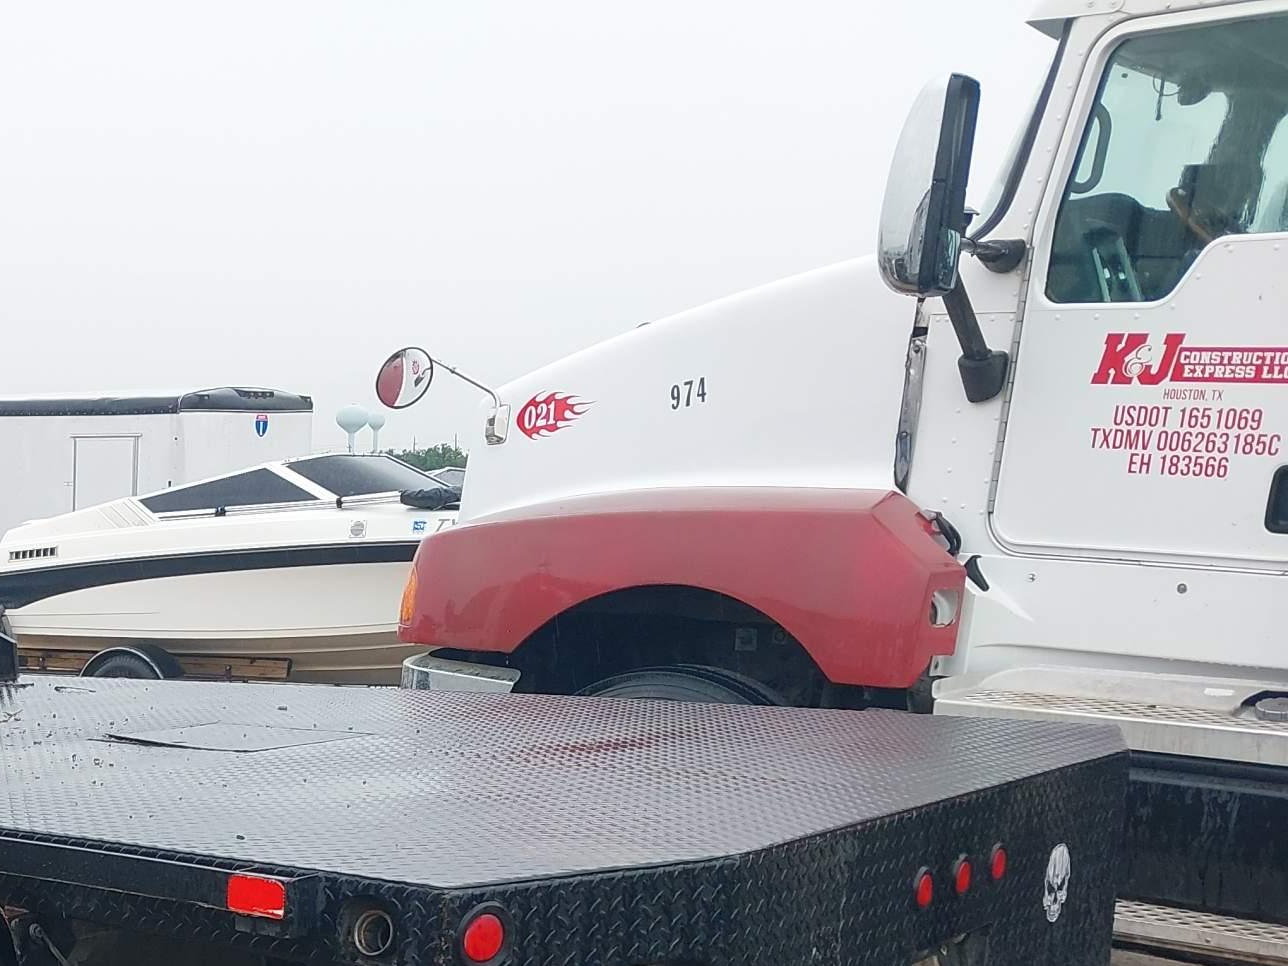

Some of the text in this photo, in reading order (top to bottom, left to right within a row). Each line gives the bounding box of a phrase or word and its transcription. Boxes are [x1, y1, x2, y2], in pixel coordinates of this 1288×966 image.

[1091, 333, 1186, 385] K&J
[1182, 366, 1256, 378] EXPRESS
[670, 377, 706, 410] 974
[1163, 389, 1224, 401] HOUSTON, TX
[524, 402, 555, 430] 021
[1113, 405, 1263, 430] USDOT 1651069
[1091, 428, 1281, 456] TXDMV 006263185C
[1128, 453, 1229, 478] EH 183566
